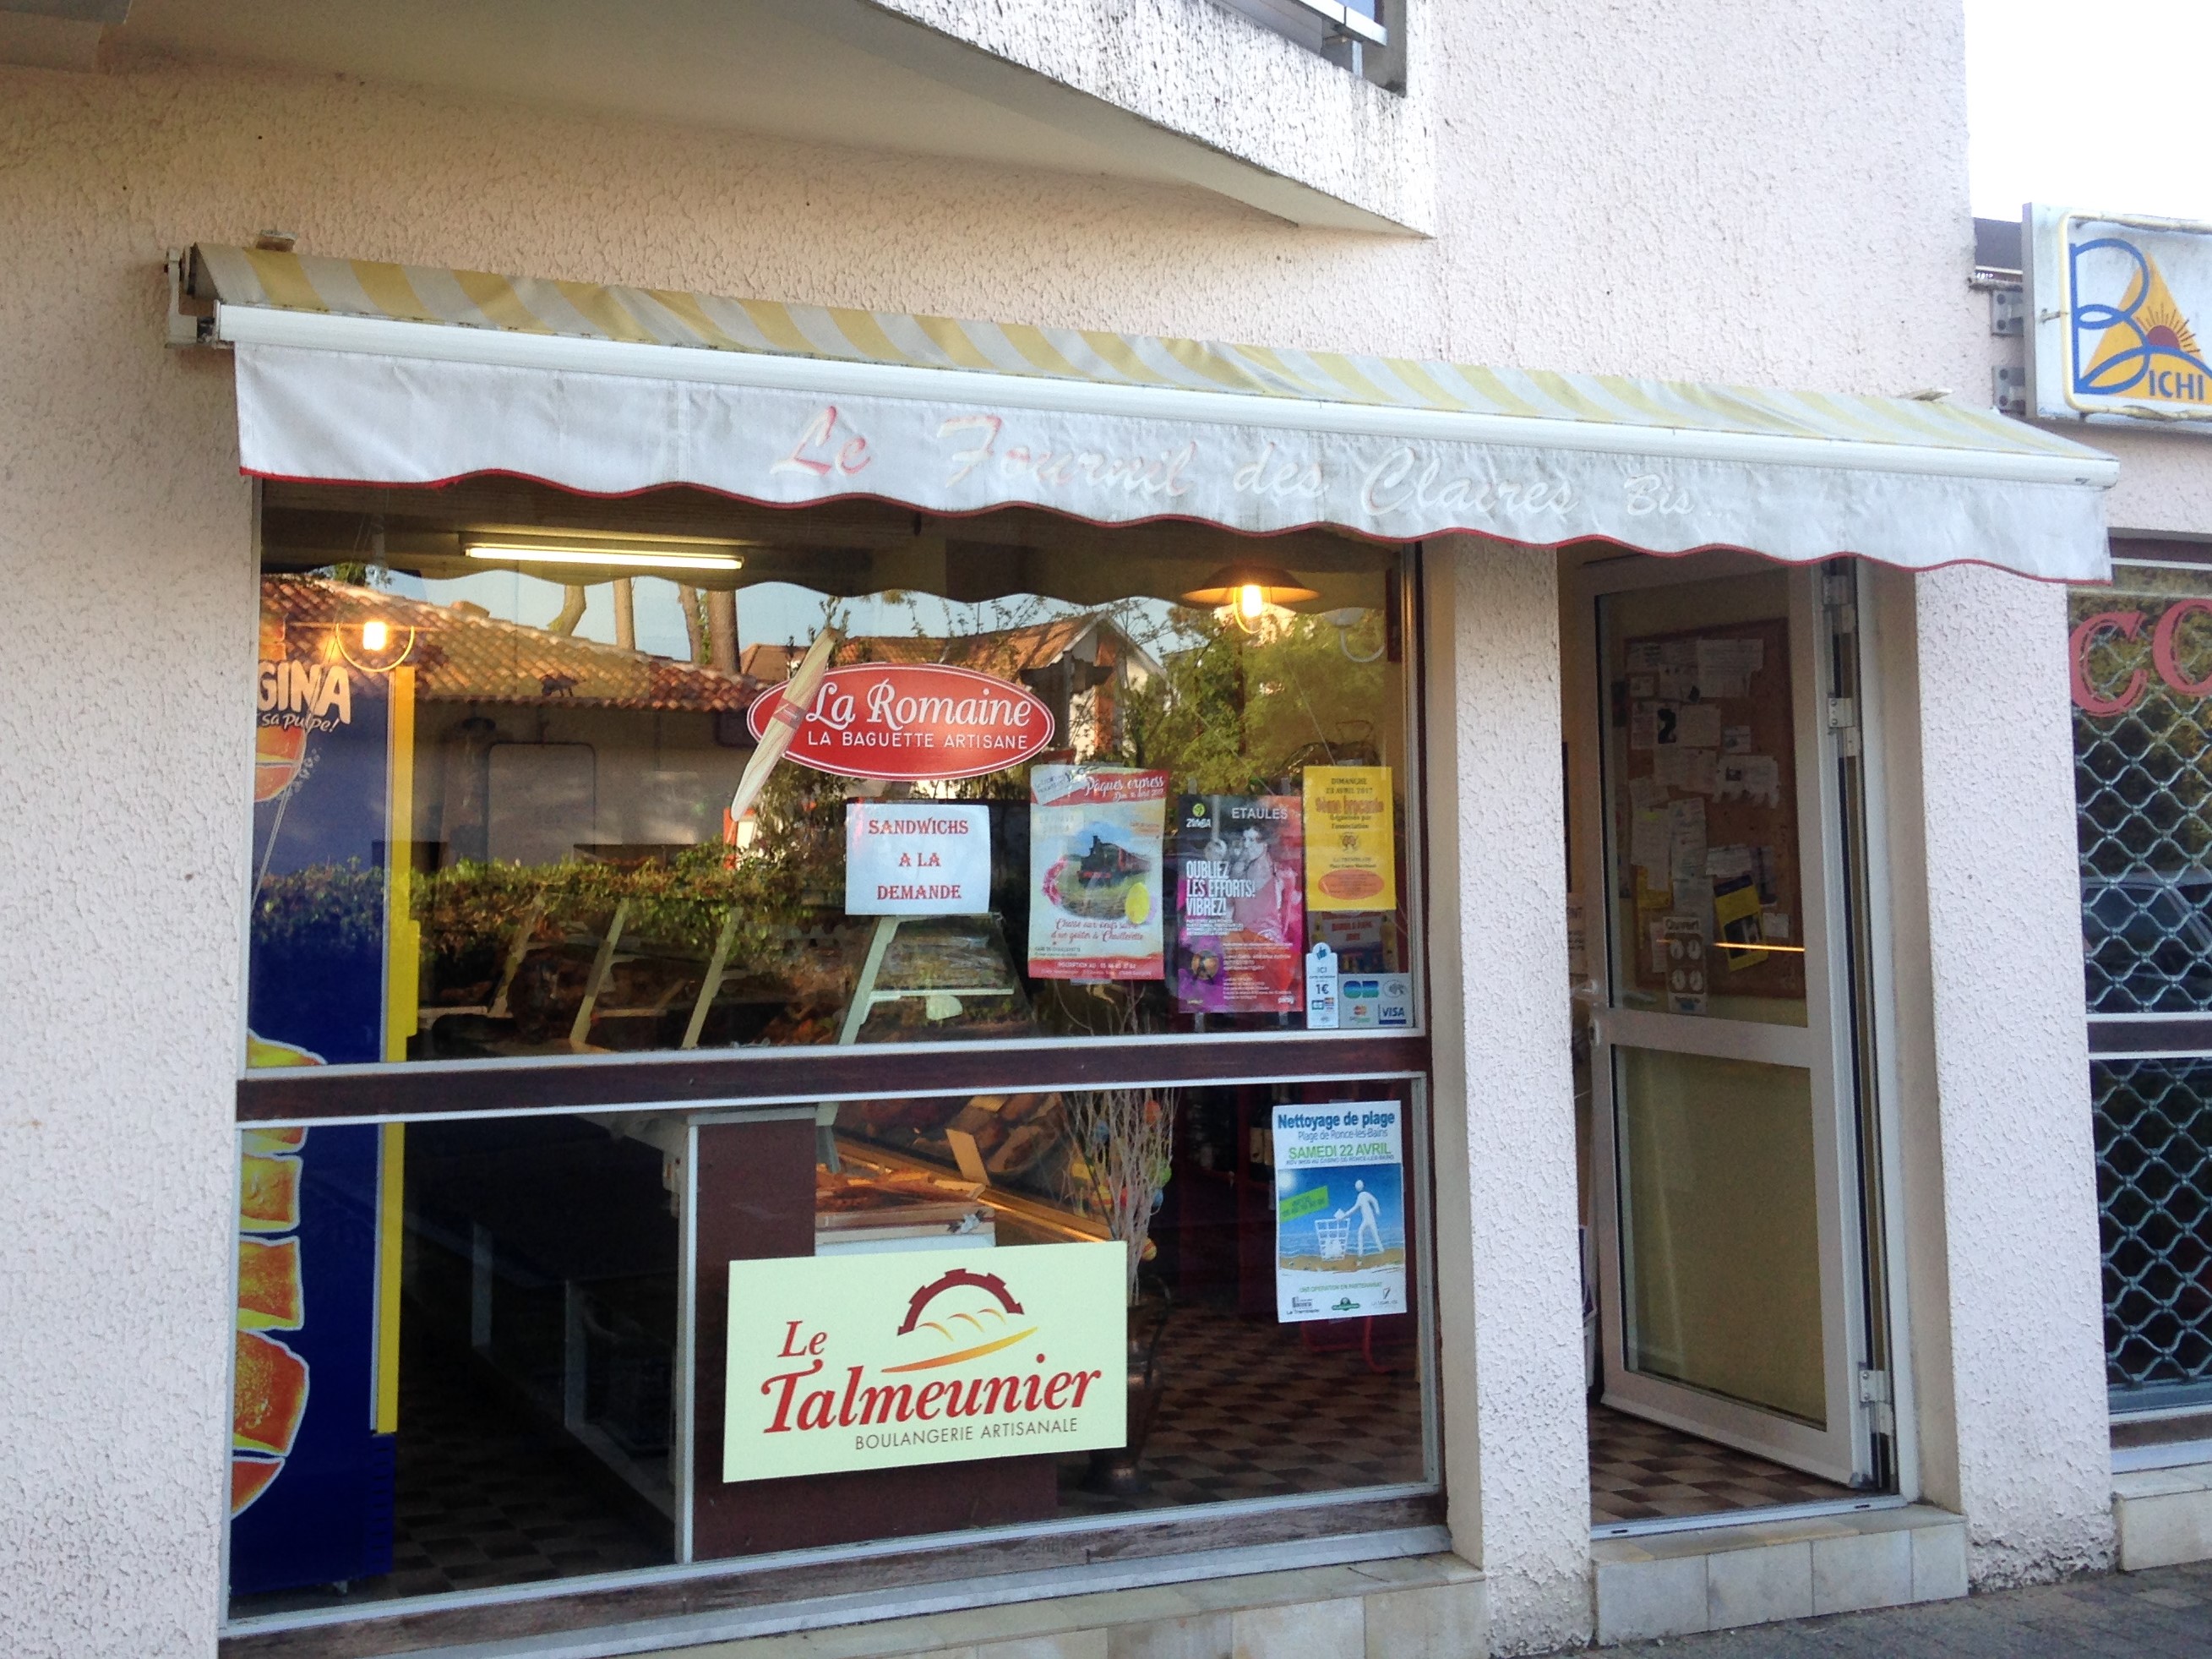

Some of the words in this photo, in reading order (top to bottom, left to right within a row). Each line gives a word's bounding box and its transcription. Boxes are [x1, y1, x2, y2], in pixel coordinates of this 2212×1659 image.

[770, 405, 872, 478] Le
[936, 415, 1198, 496] Fournil
[1233, 440, 1330, 496] des
[1361, 446, 1579, 517] Claires
[805, 680, 857, 731] La
[865, 677, 1032, 732] Romaine
[261, 713, 281, 727] sa
[282, 713, 341, 734] pulpe!
[807, 730, 832, 747] LA
[842, 731, 934, 749] BAGUETTE
[943, 733, 1029, 750] ARTISANE
[1231, 807, 1289, 820] ETAULES
[868, 816, 969, 836] SANDWICHS
[898, 852, 912, 867] A
[917, 852, 942, 868] LA
[1185, 860, 1229, 880] OUBLIEZ
[876, 884, 962, 901] DEMANDE
[1185, 880, 1206, 898] LES
[1207, 879, 1256, 898] EFFORTS!
[1185, 898, 1227, 916] VIBREZ!
[1316, 984, 1330, 995] 1€
[1381, 1007, 1406, 1018] VISA
[1278, 1113, 1341, 1132] Nettoyage
[1343, 1111, 1359, 1127] de
[1361, 1111, 1396, 1129] plage
[1298, 1130, 1319, 1143] Plage
[1319, 1129, 1329, 1141] de
[1289, 1144, 1338, 1160] SAMEDI
[1339, 1143, 1354, 1157] 22
[1355, 1142, 1392, 1156] AVRIL
[776, 1320, 828, 1357] Le
[760, 1353, 1102, 1433] Talmeunier
[855, 1426, 973, 1450] BOULANGERIE
[980, 1417, 1078, 1440] ARTISANALE
